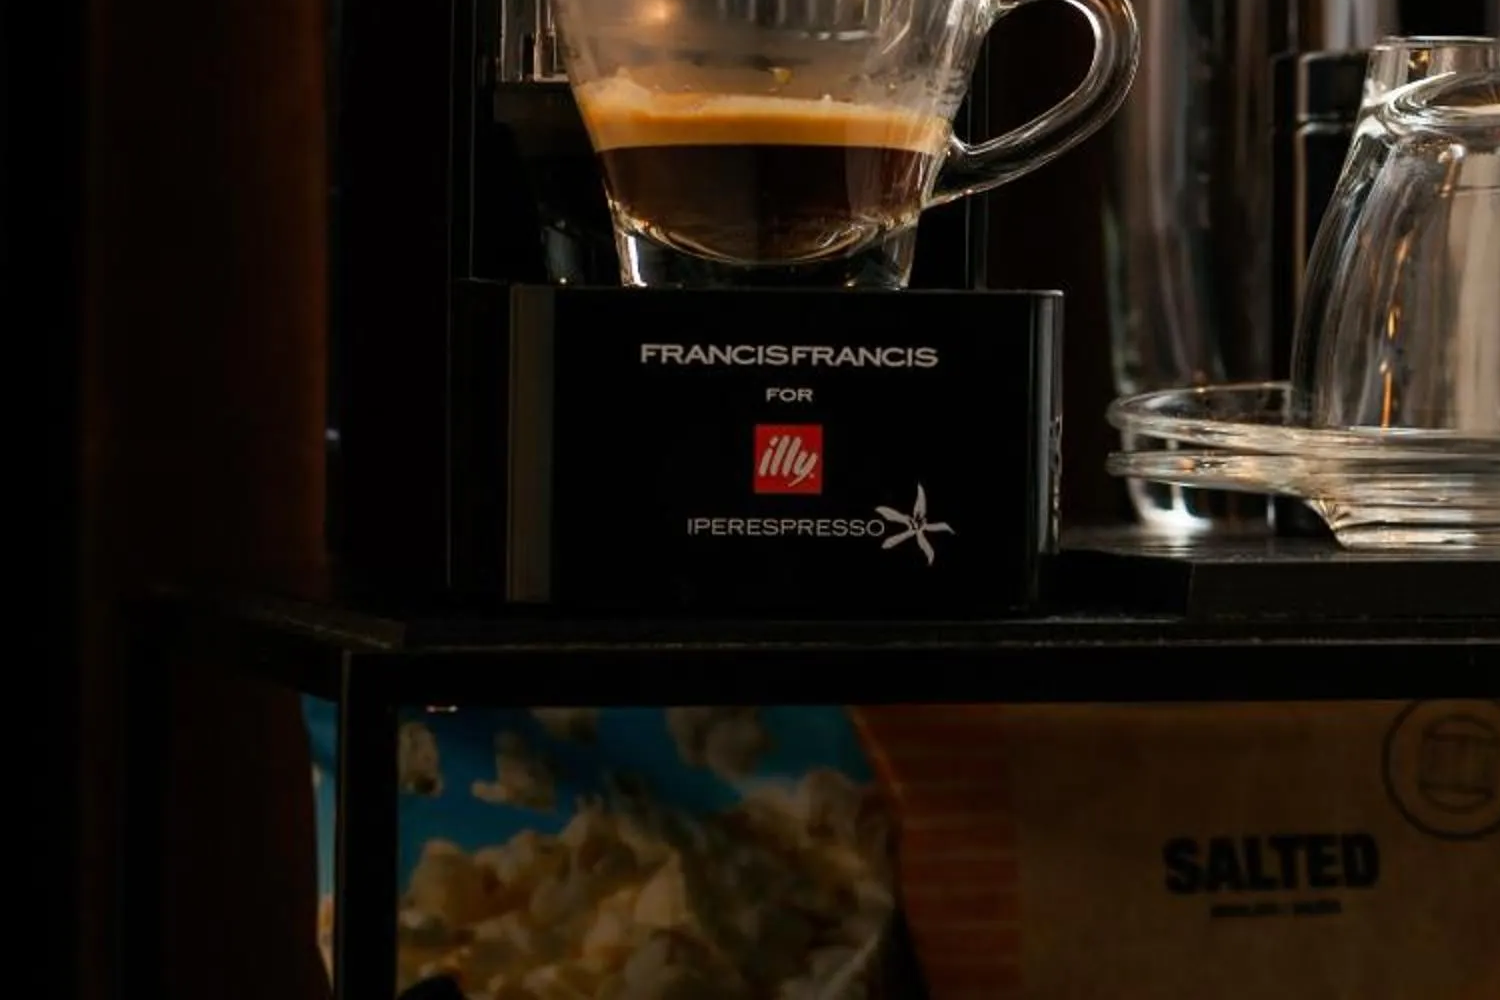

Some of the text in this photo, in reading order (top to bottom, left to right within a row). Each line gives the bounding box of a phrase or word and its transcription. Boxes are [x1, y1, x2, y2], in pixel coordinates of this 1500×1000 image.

[640, 343, 939, 368] FRANCISFRANCIS
[765, 387, 814, 402] FOR
[758, 435, 818, 487] illy
[687, 517, 885, 537] IPERESPRESSO
[1163, 833, 1379, 893] SALTED
